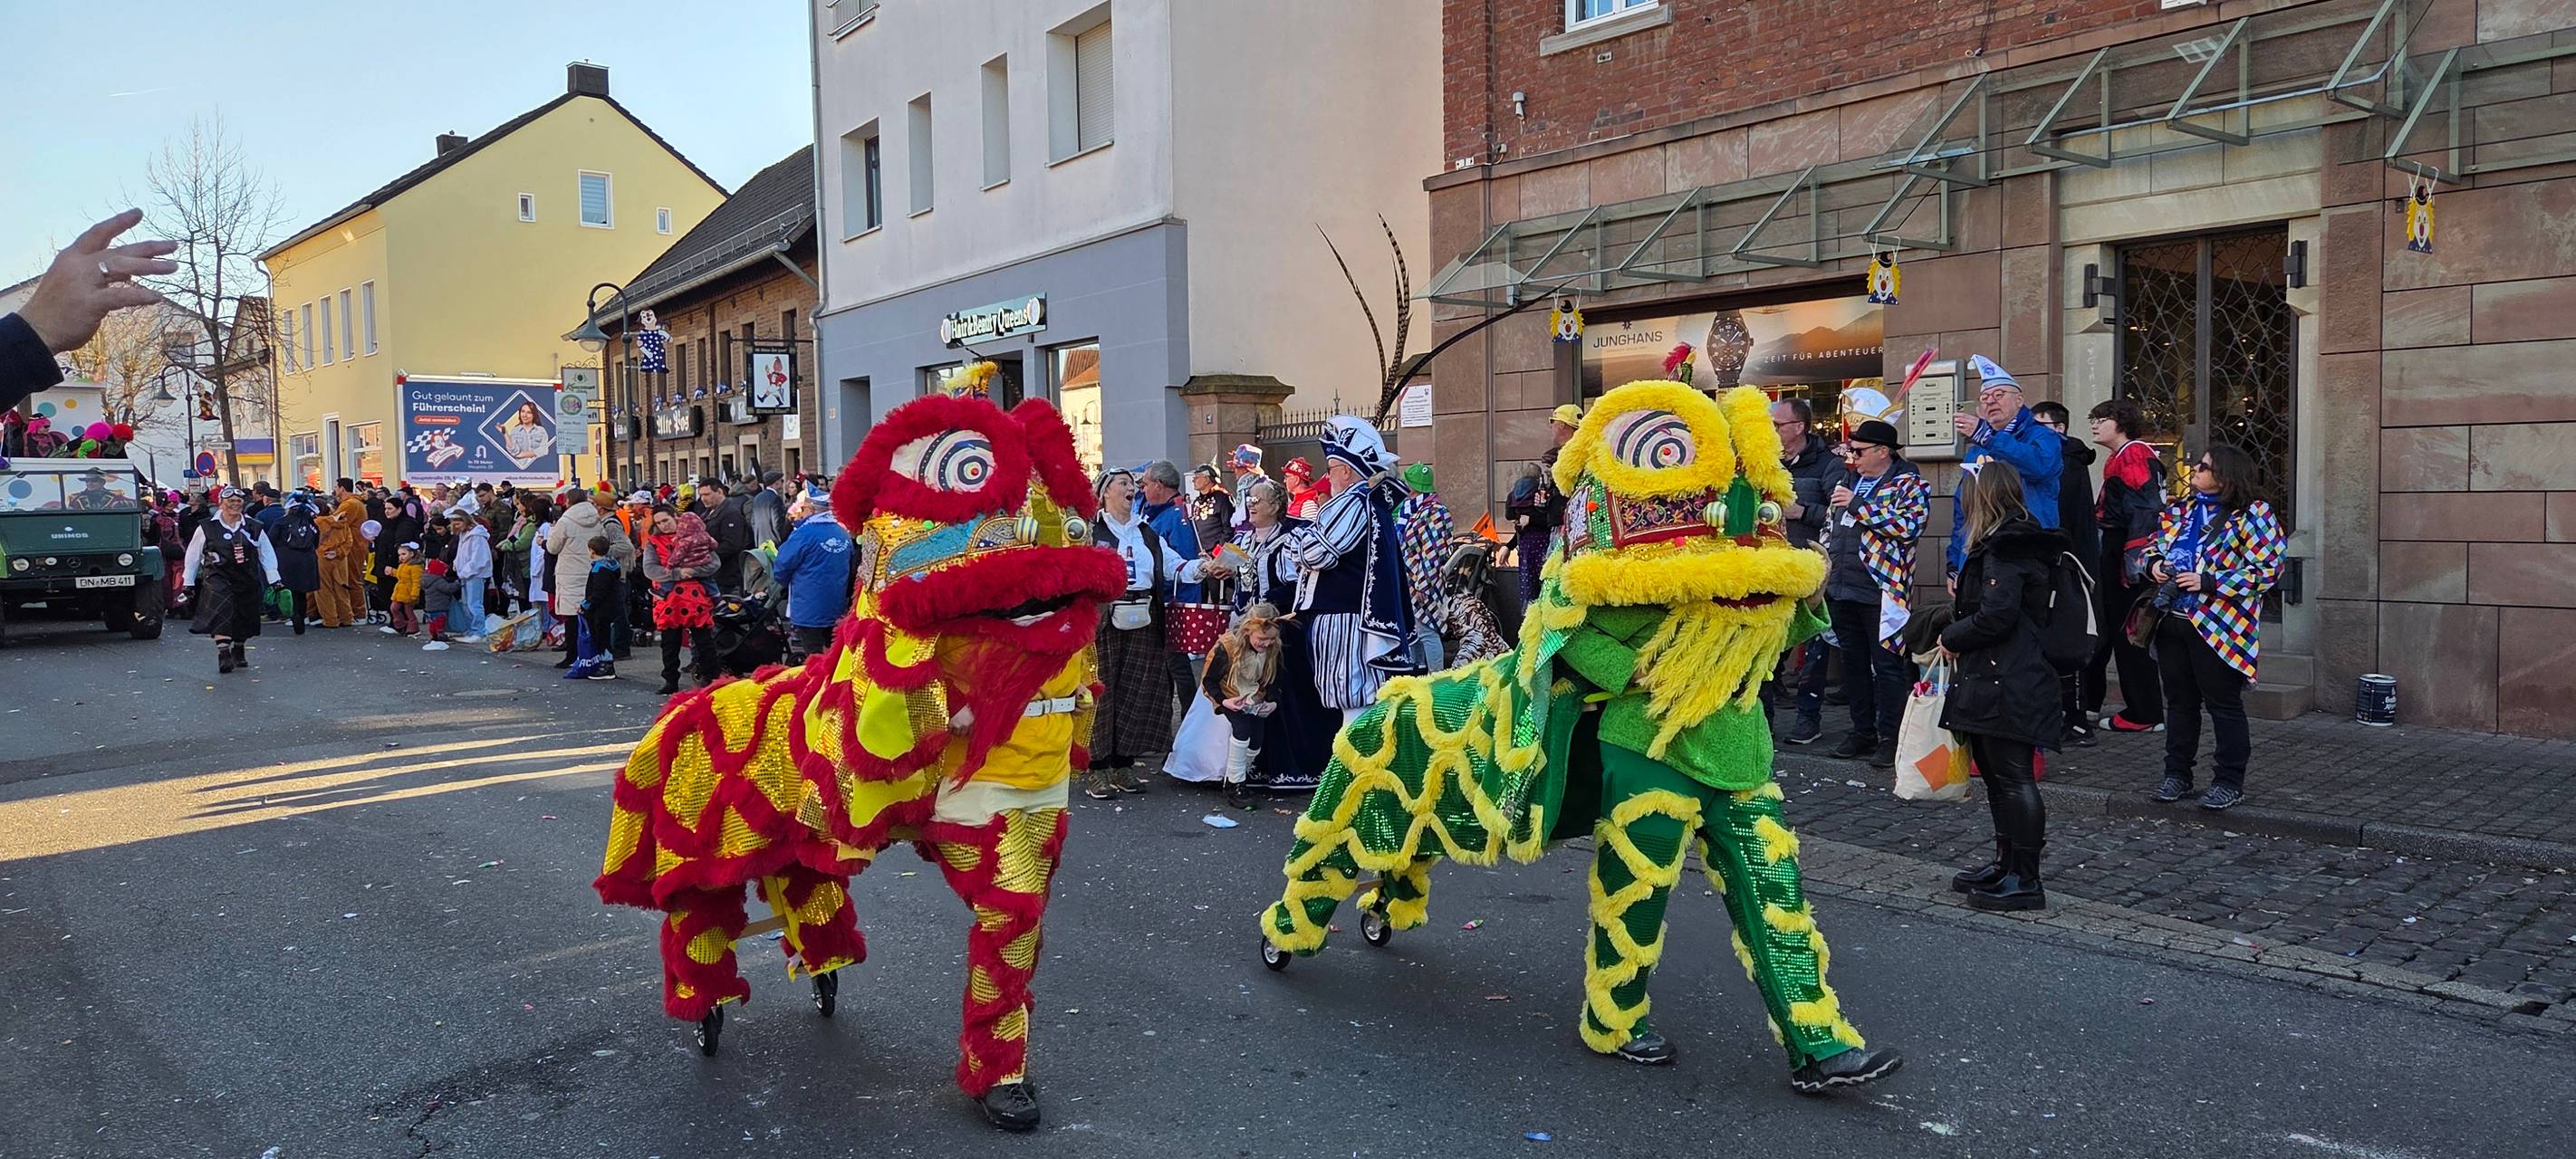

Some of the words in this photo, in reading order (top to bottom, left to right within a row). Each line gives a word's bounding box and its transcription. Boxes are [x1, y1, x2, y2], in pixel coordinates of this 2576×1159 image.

[951, 313, 998, 339] Hair&Beauty
[997, 307, 1028, 332] Queens
[1592, 330, 1663, 349] JUNGHANS
[1764, 354, 1788, 363] ZEIT
[1793, 351, 1812, 361] FÜR
[1818, 346, 1884, 359] ABENTEUER
[411, 390, 433, 400] Gut
[434, 392, 472, 403] gelaunt
[412, 402, 485, 413] Führerschein!
[101, 577, 116, 586] MB
[118, 577, 131, 585] 411
